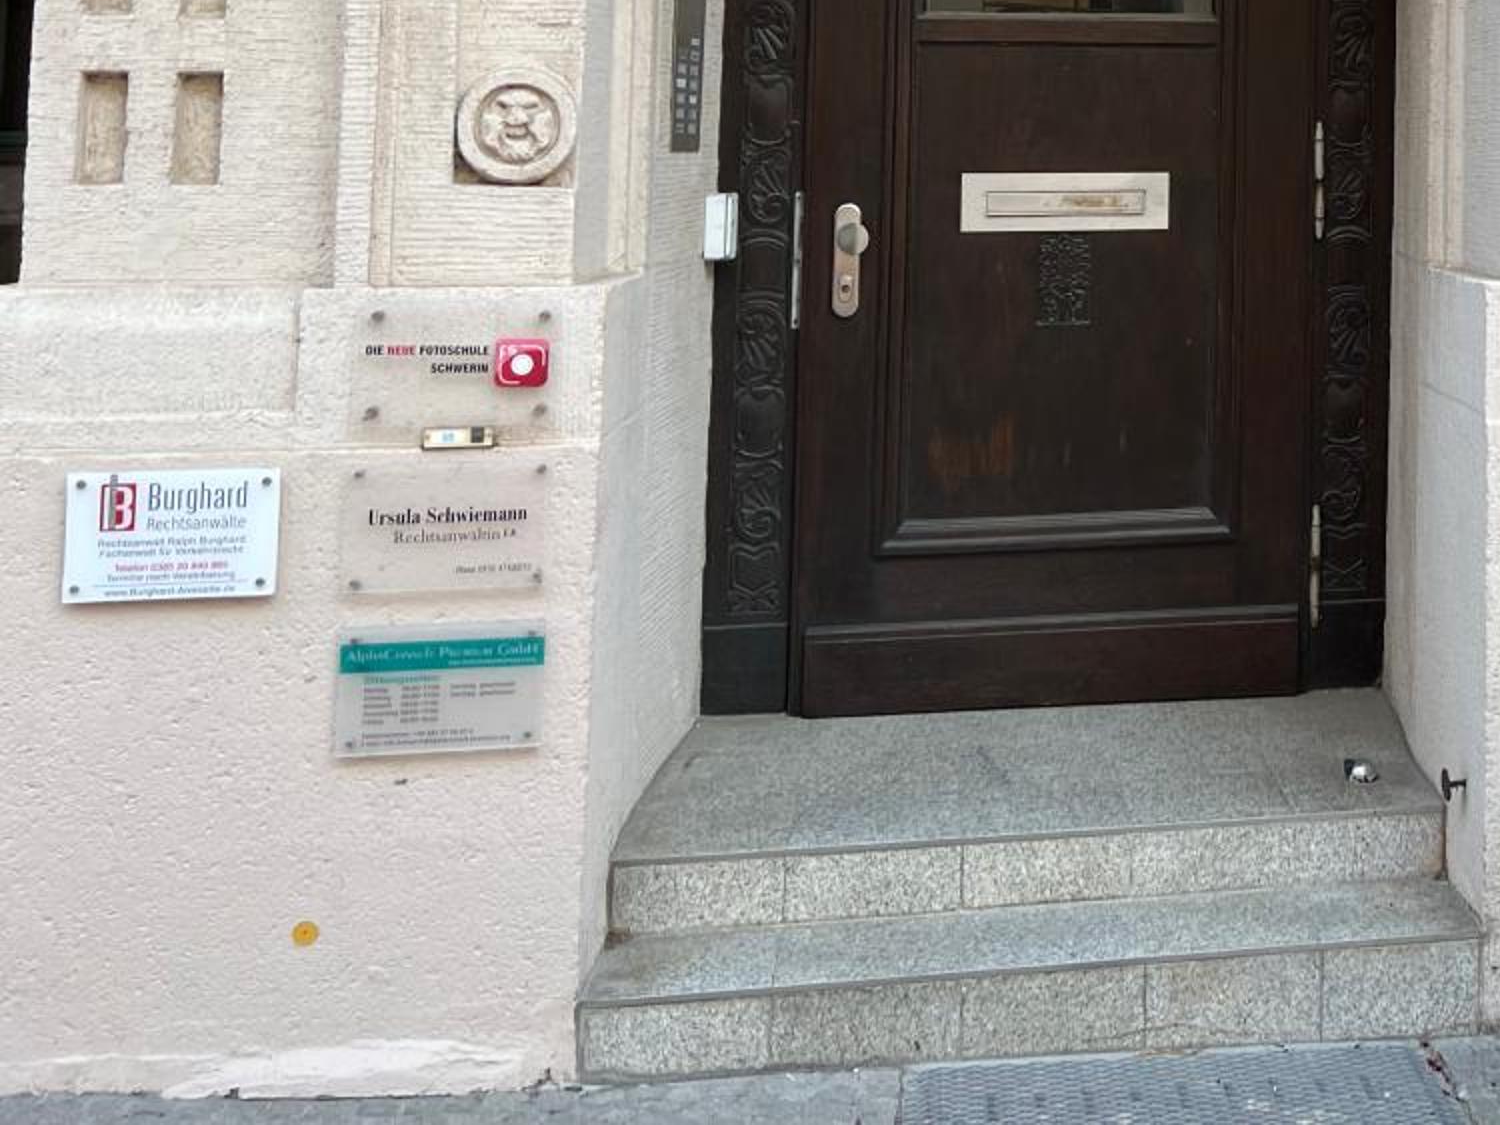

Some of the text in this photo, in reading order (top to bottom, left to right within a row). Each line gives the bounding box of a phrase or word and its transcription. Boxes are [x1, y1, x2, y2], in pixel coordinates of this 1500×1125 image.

[365, 344, 384, 356] DIE
[419, 344, 489, 356] FOTOSCHULE
[430, 362, 489, 374] SCHWERIN
[148, 481, 248, 514] Burghard
[146, 514, 248, 531] Rechtsanwälte
[368, 506, 528, 526] Ursula Schwiemann
